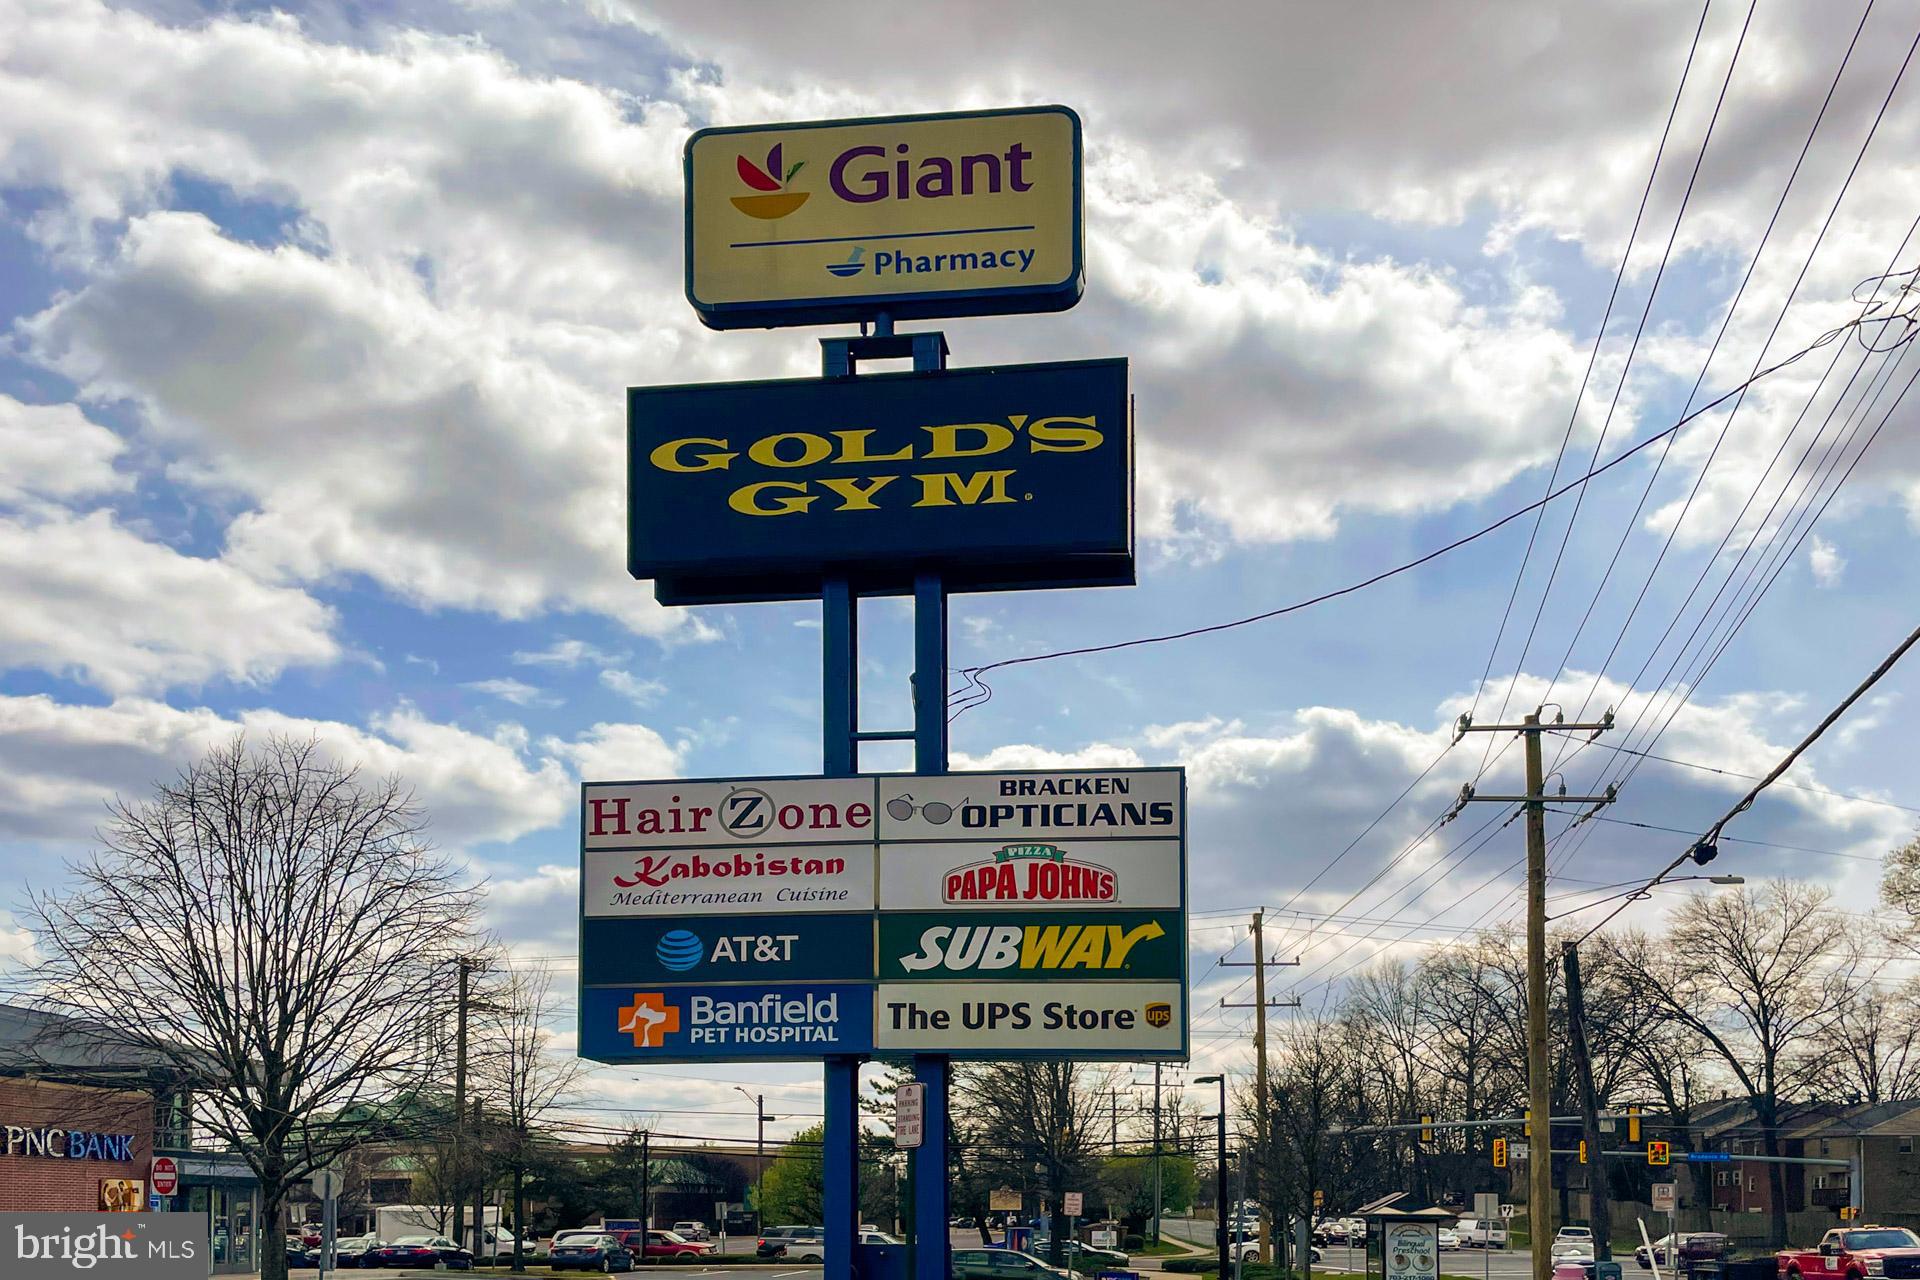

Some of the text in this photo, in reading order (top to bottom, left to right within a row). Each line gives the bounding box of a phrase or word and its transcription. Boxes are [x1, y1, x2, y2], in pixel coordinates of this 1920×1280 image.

[829, 142, 1034, 203] Giant
[875, 248, 1035, 276] Pharmacy
[650, 415, 1104, 473] GOLD'S
[1000, 777, 1130, 797] BRACKEN
[588, 787, 872, 838] Hair Zone
[961, 802, 1174, 828] OPTICIANS
[1007, 846, 1052, 857] PIZZA
[613, 853, 845, 888] Kabobistan
[947, 863, 1017, 900] PAPA
[609, 887, 849, 907] Mediterranean Cuisine
[710, 935, 799, 963] AT&T
[899, 919, 1166, 973] SUBWAY
[690, 992, 839, 1026] Banfield
[887, 1002, 1135, 1029] The UPS Store
[1147, 1009, 1171, 1025] ups
[690, 1026, 839, 1043] PET HOSPITAL
[5, 1125, 135, 1161] PNC BANK
[1392, 1246, 1431, 1255] Preschool
